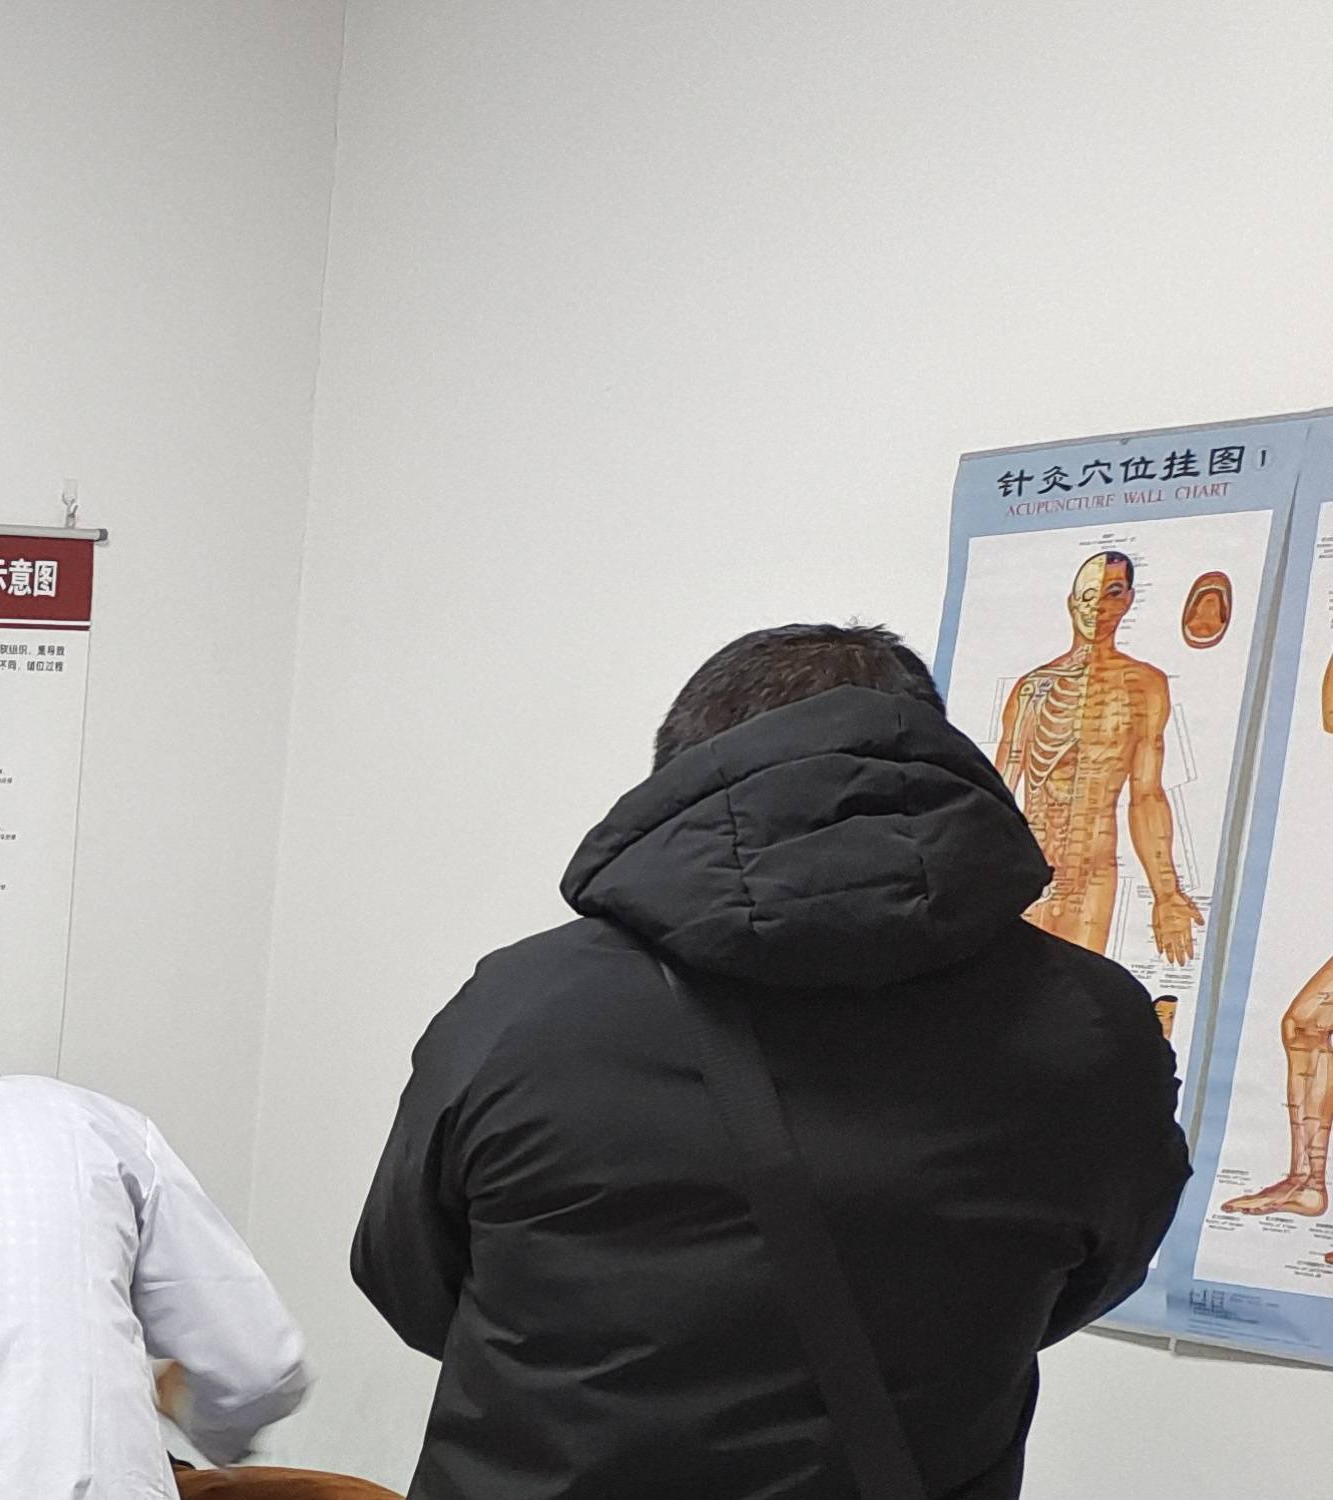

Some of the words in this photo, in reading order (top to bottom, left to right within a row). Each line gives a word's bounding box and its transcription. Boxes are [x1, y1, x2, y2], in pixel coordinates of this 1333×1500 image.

[997, 445, 1245, 497] 针灸穴位挂图
[1006, 494, 1114, 518] ACUPUNCTURE
[1124, 489, 1164, 505] WALL
[1175, 482, 1232, 500] CHART
